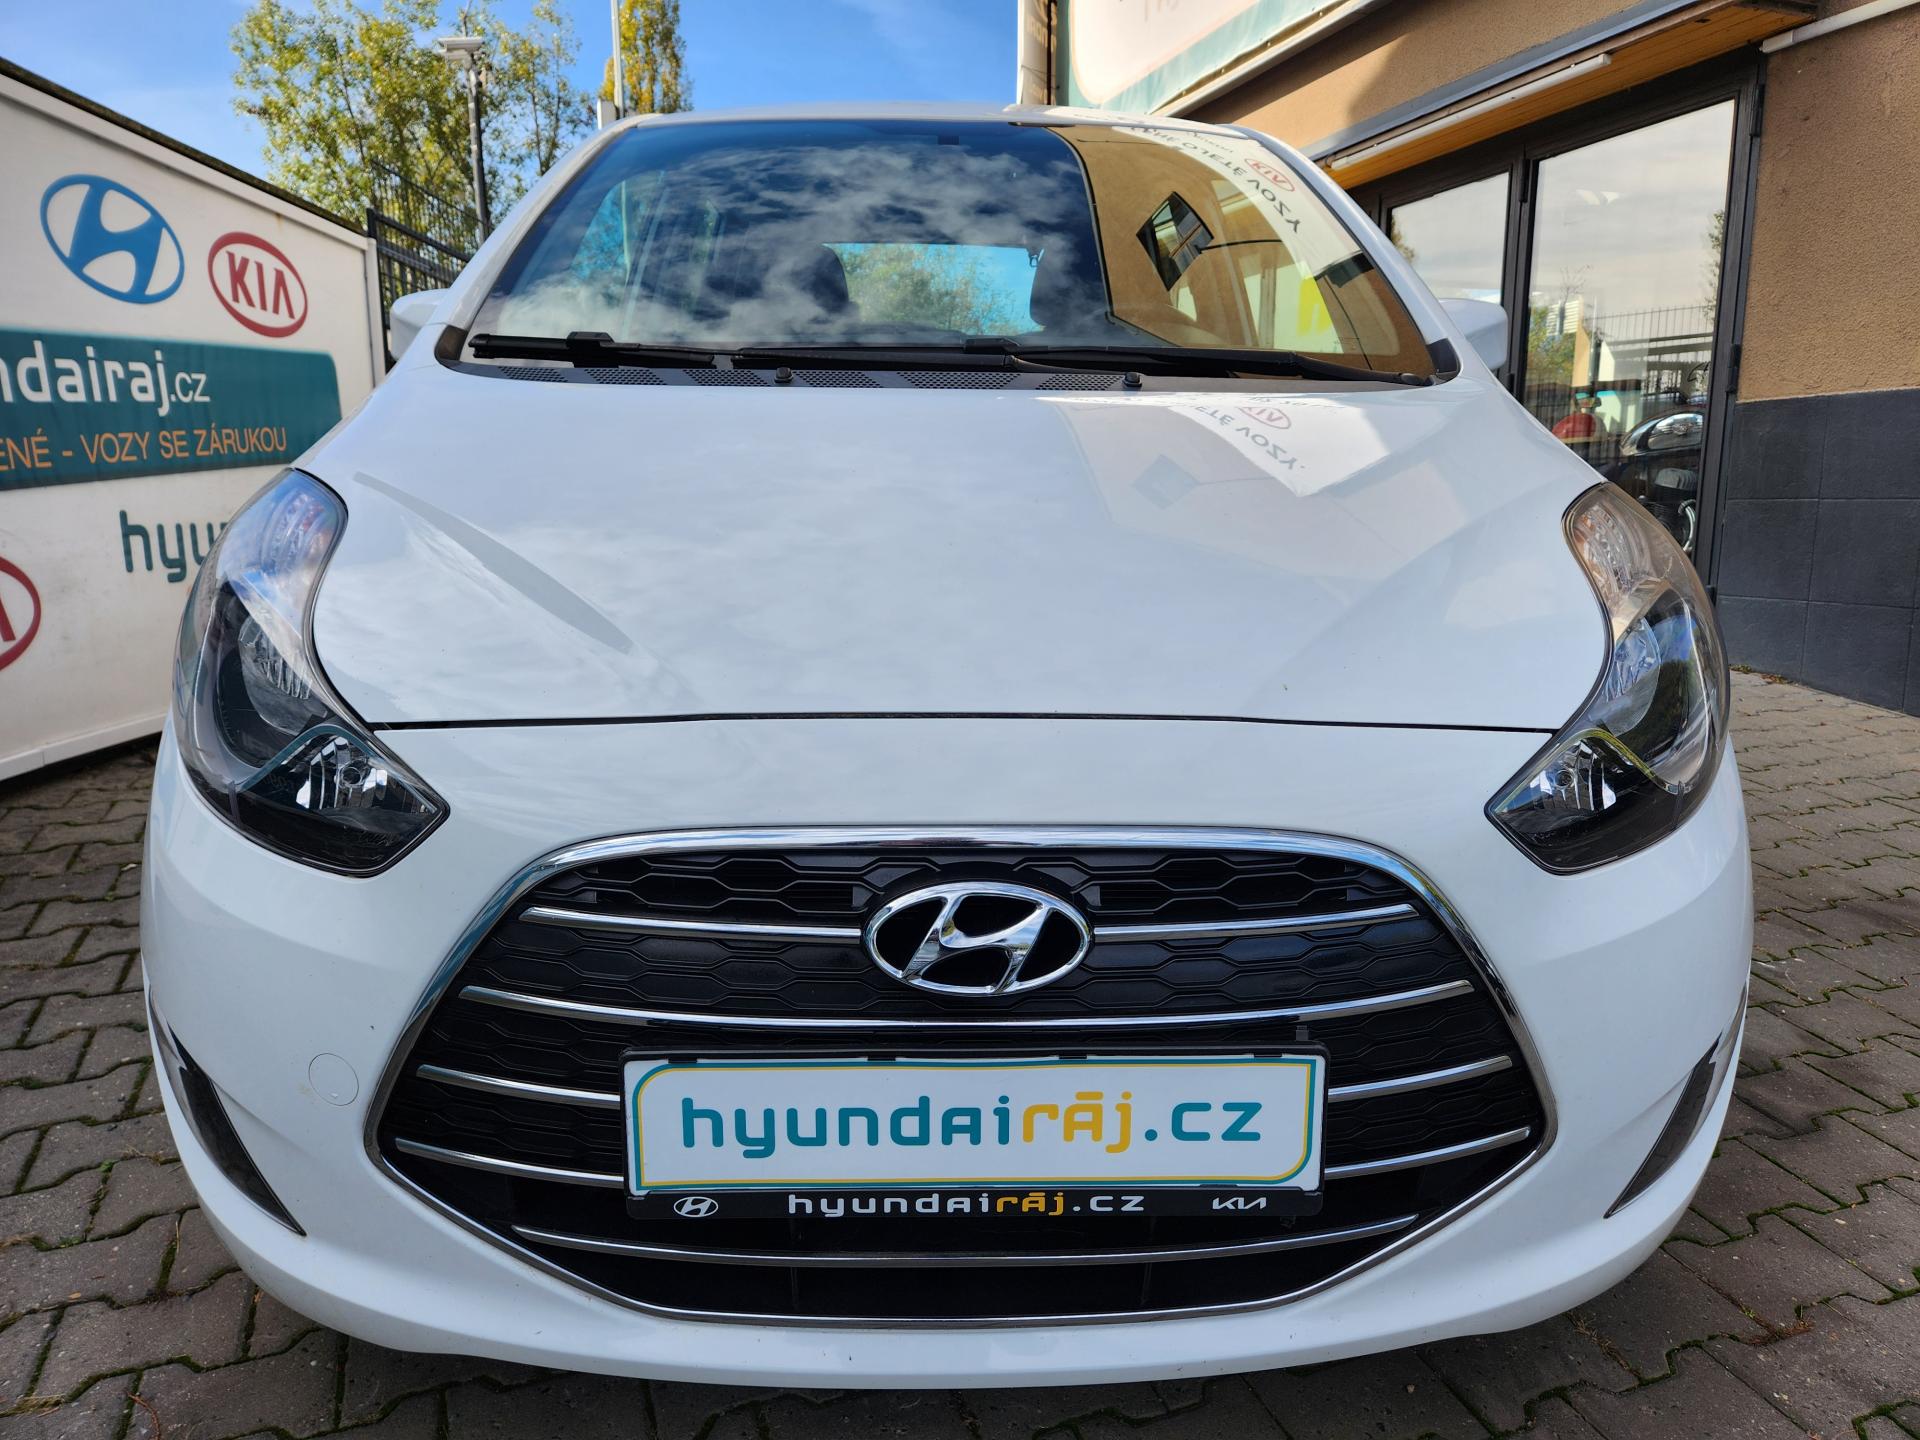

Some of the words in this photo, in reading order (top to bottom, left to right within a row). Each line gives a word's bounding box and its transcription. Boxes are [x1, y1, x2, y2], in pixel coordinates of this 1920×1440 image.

[225, 250, 296, 320] KIA
[80, 430, 153, 464] VOZY
[159, 430, 189, 459] SE
[195, 422, 288, 456] ZÁRUKOU
[119, 510, 228, 583] hyu
